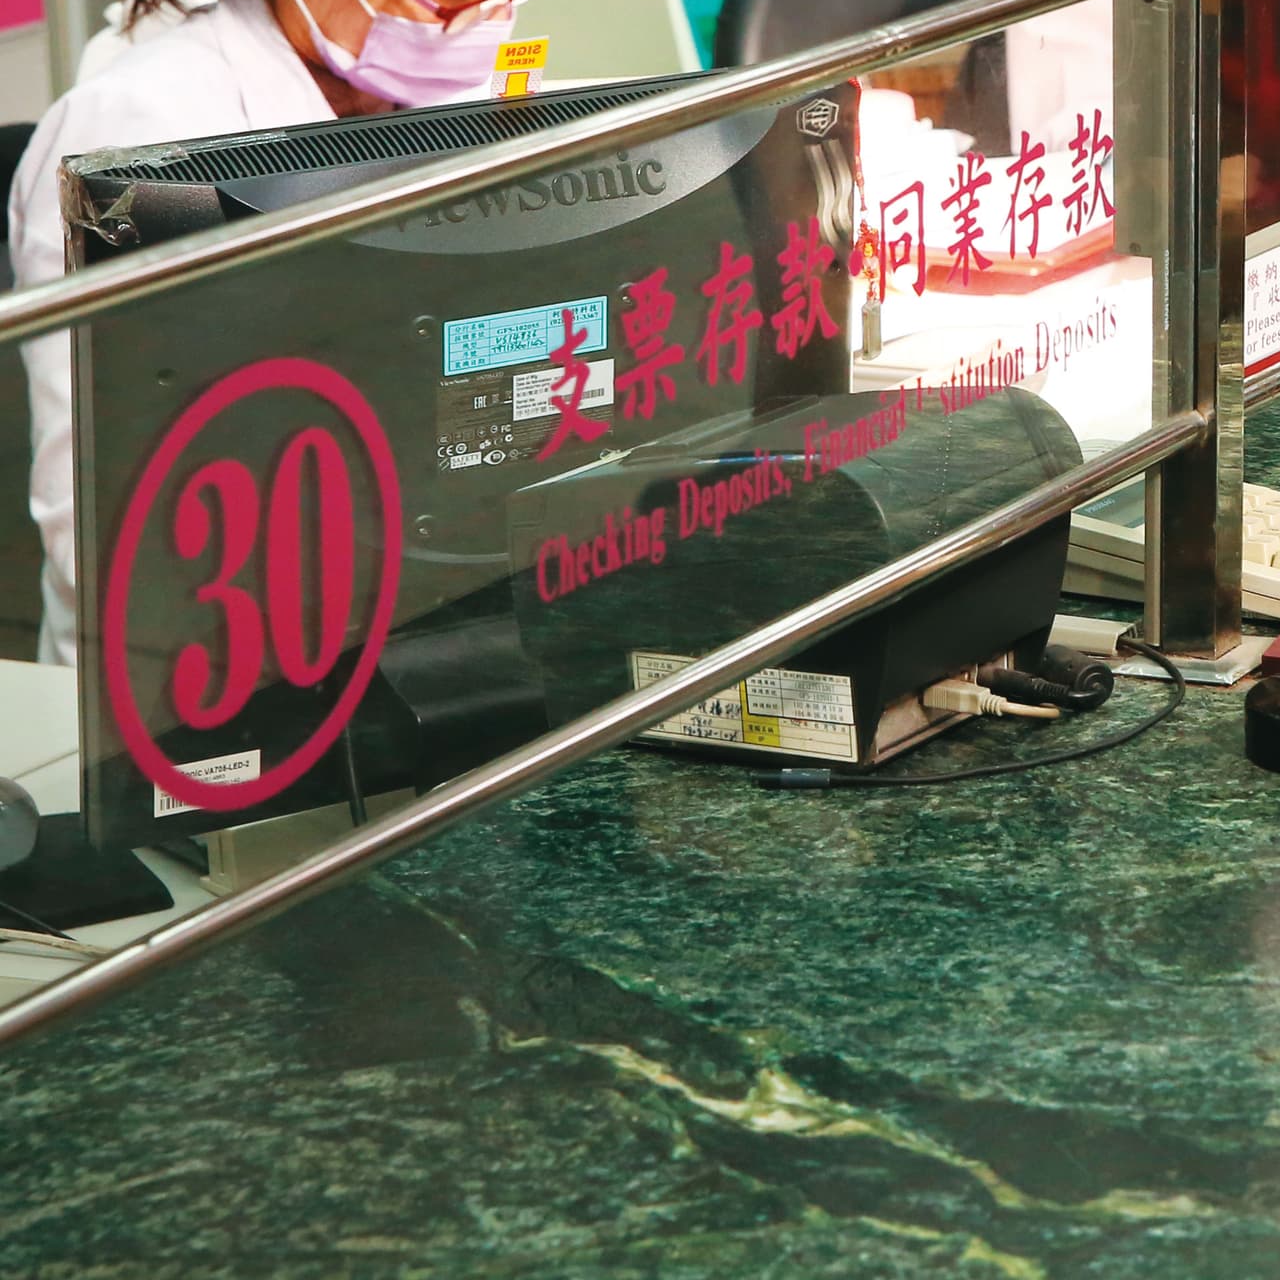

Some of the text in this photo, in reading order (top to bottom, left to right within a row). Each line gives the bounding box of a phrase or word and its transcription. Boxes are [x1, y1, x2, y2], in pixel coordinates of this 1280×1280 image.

[1246, 311, 1280, 336] Please
[1246, 341, 1258, 355] or
[537, 506, 667, 603] Checking
[678, 448, 792, 539] Deposits,
[803, 385, 907, 483] Financial
[1035, 296, 1117, 372] Deposits
[173, 425, 355, 730] 30
